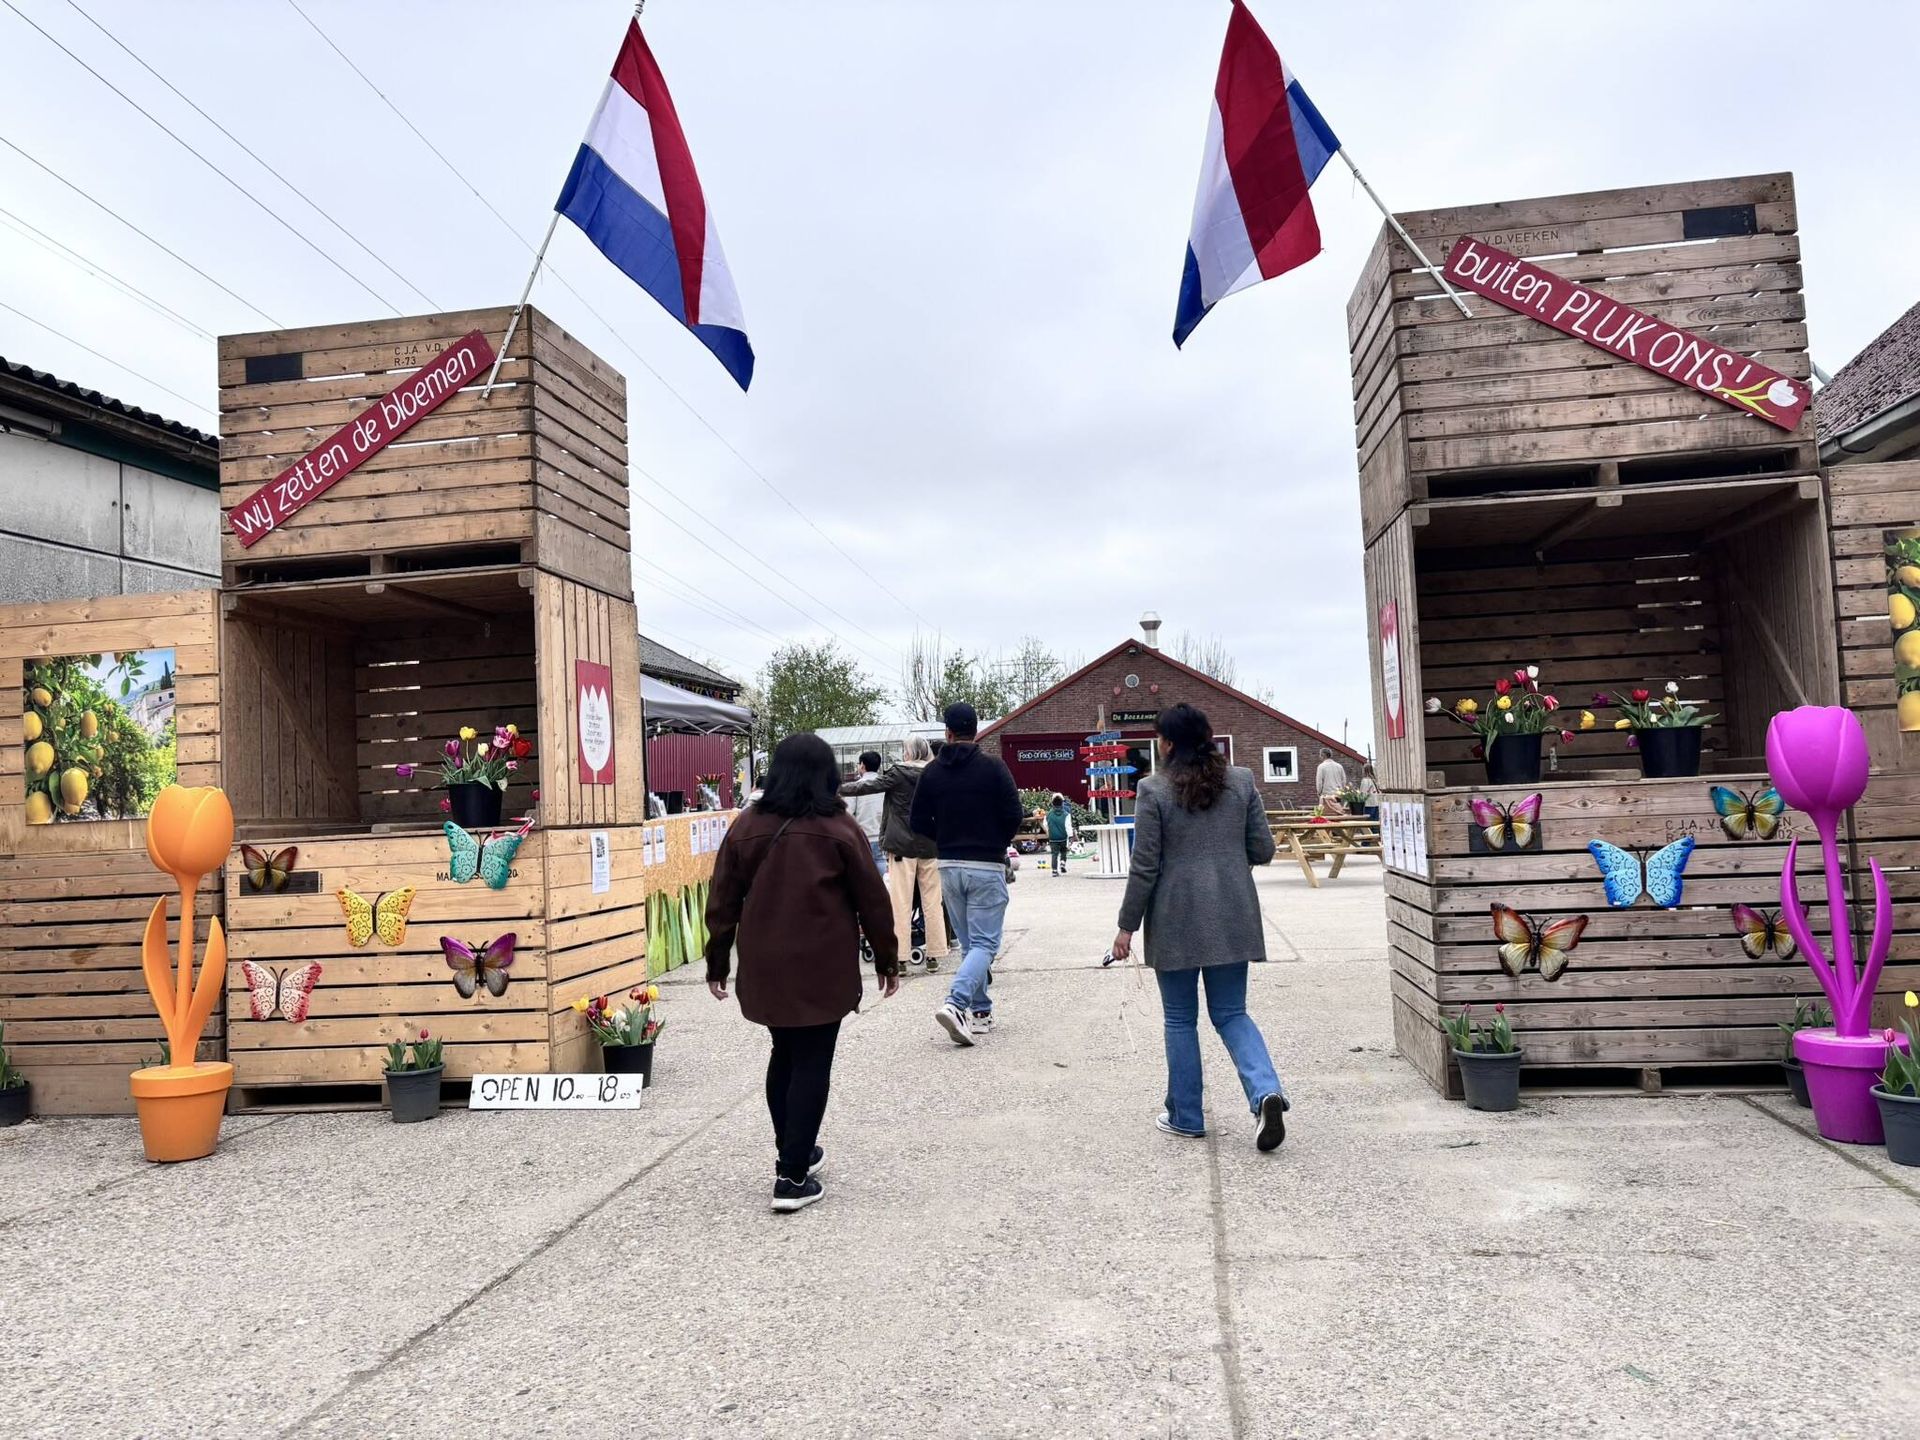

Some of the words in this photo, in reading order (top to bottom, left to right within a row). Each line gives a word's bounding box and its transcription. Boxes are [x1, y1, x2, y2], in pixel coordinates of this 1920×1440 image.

[394, 356, 416, 366] R-73
[1553, 289, 1656, 357] PLUK
[1649, 332, 1752, 399] ONS!
[273, 444, 349, 511] zetten
[353, 421, 381, 452] de
[380, 347, 476, 430] bloemen
[481, 1077, 540, 1102] OPEN
